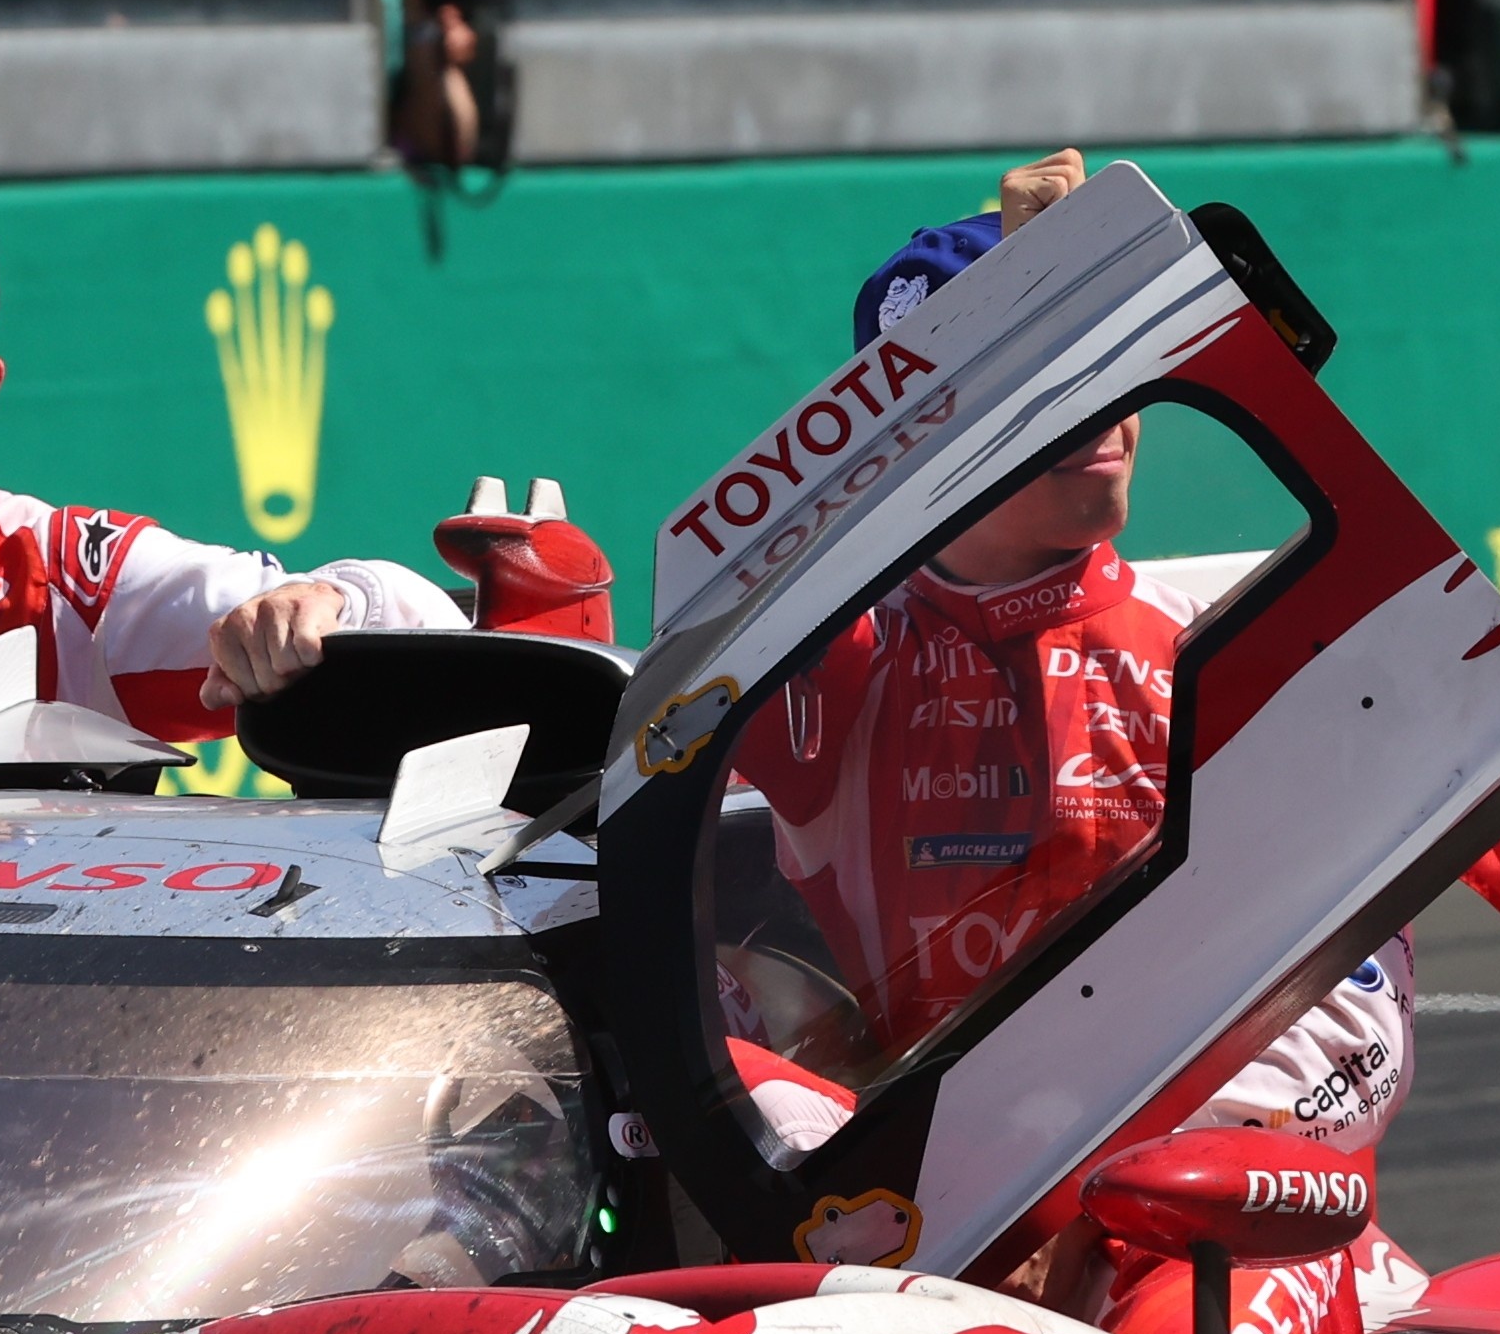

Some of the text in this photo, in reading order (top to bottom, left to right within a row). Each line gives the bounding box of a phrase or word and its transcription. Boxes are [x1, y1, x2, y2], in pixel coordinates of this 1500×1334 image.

[670, 339, 940, 558] TOYOTA
[989, 580, 1086, 621] TOYOTA
[1046, 647, 1173, 699] DENS
[908, 695, 1019, 730] AISIN
[902, 763, 1000, 802] Mobil
[1055, 796, 1079, 807] FIA
[1081, 797, 1132, 809] WORLD
[940, 843, 1025, 857] MICHELIN
[908, 908, 1040, 980] TOY
[1294, 1026, 1390, 1123] capital
[1333, 1109, 1357, 1133] an
[1358, 1067, 1400, 1115] edge
[1241, 1170, 1368, 1217] DENSO
